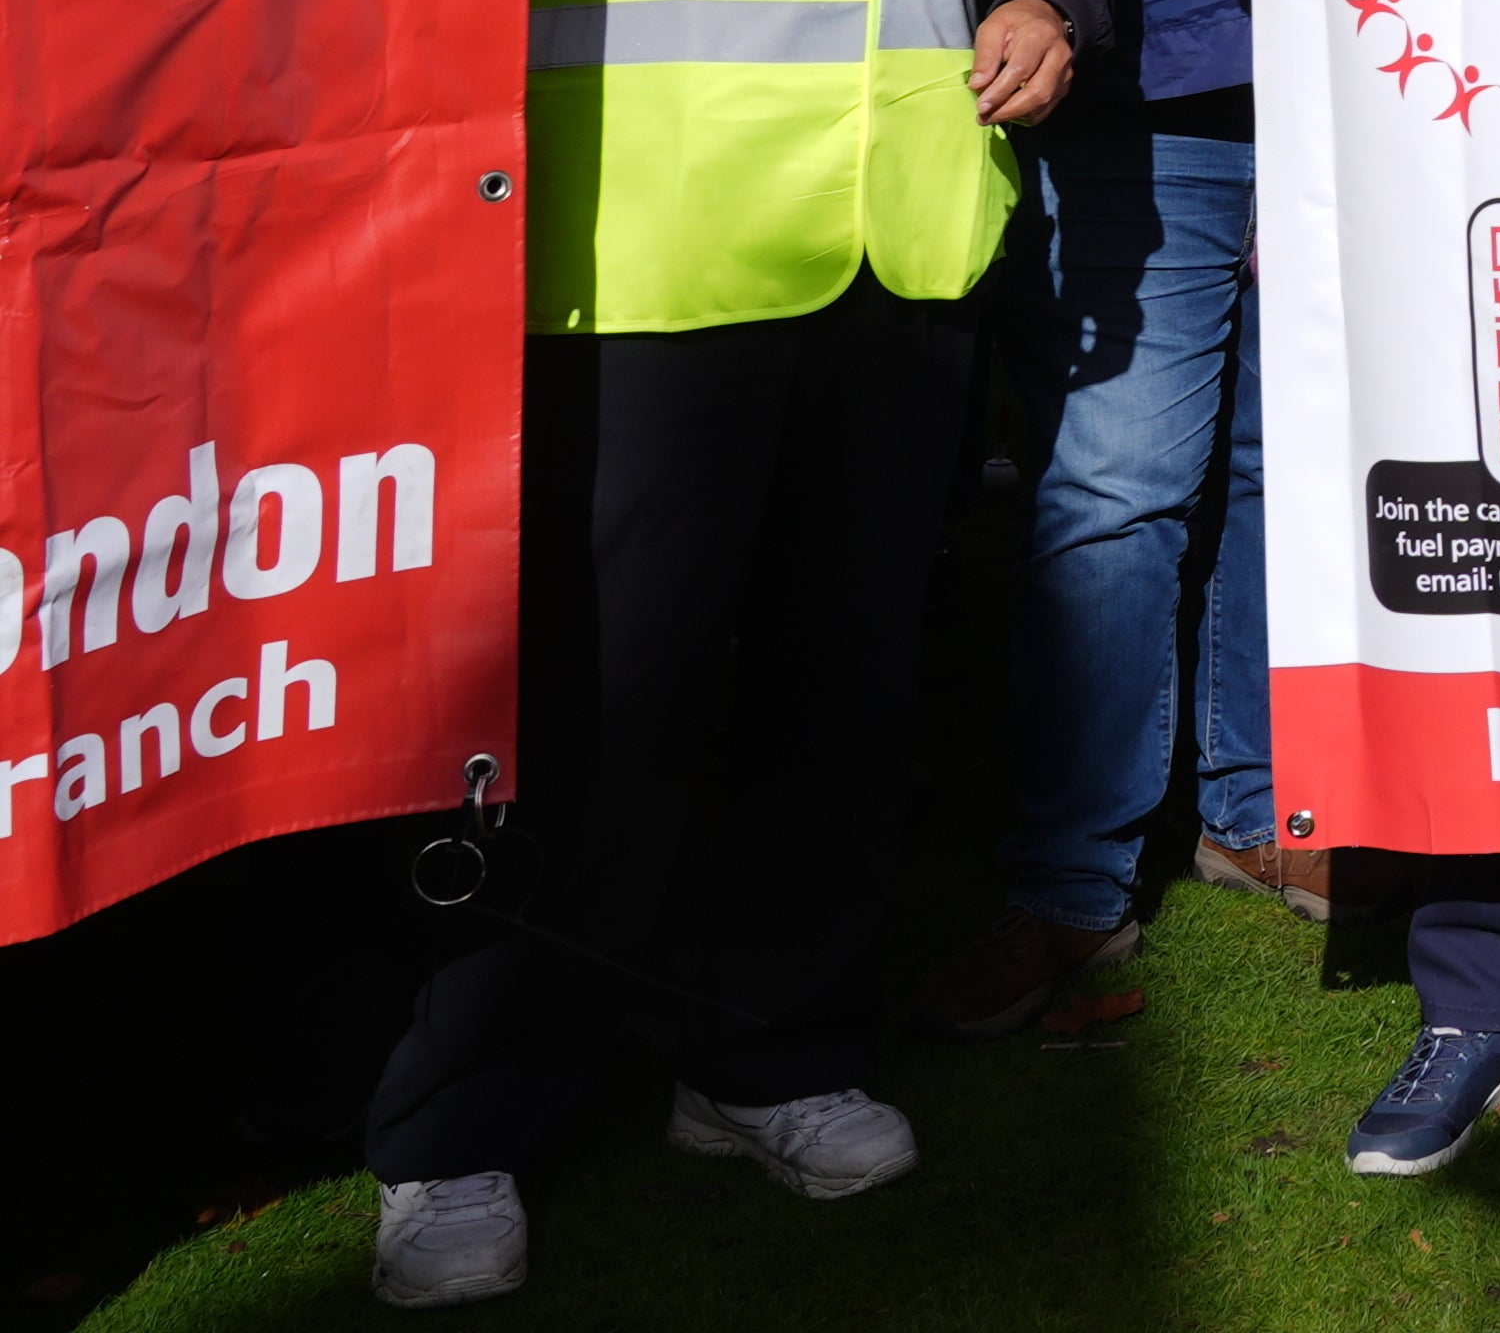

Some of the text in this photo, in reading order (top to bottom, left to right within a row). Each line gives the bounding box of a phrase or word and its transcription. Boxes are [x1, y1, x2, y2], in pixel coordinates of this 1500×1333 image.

[1375, 495, 1419, 522] Join
[1425, 498, 1470, 523] the
[1396, 531, 1443, 558] fuel
[1415, 568, 1494, 593] email:
